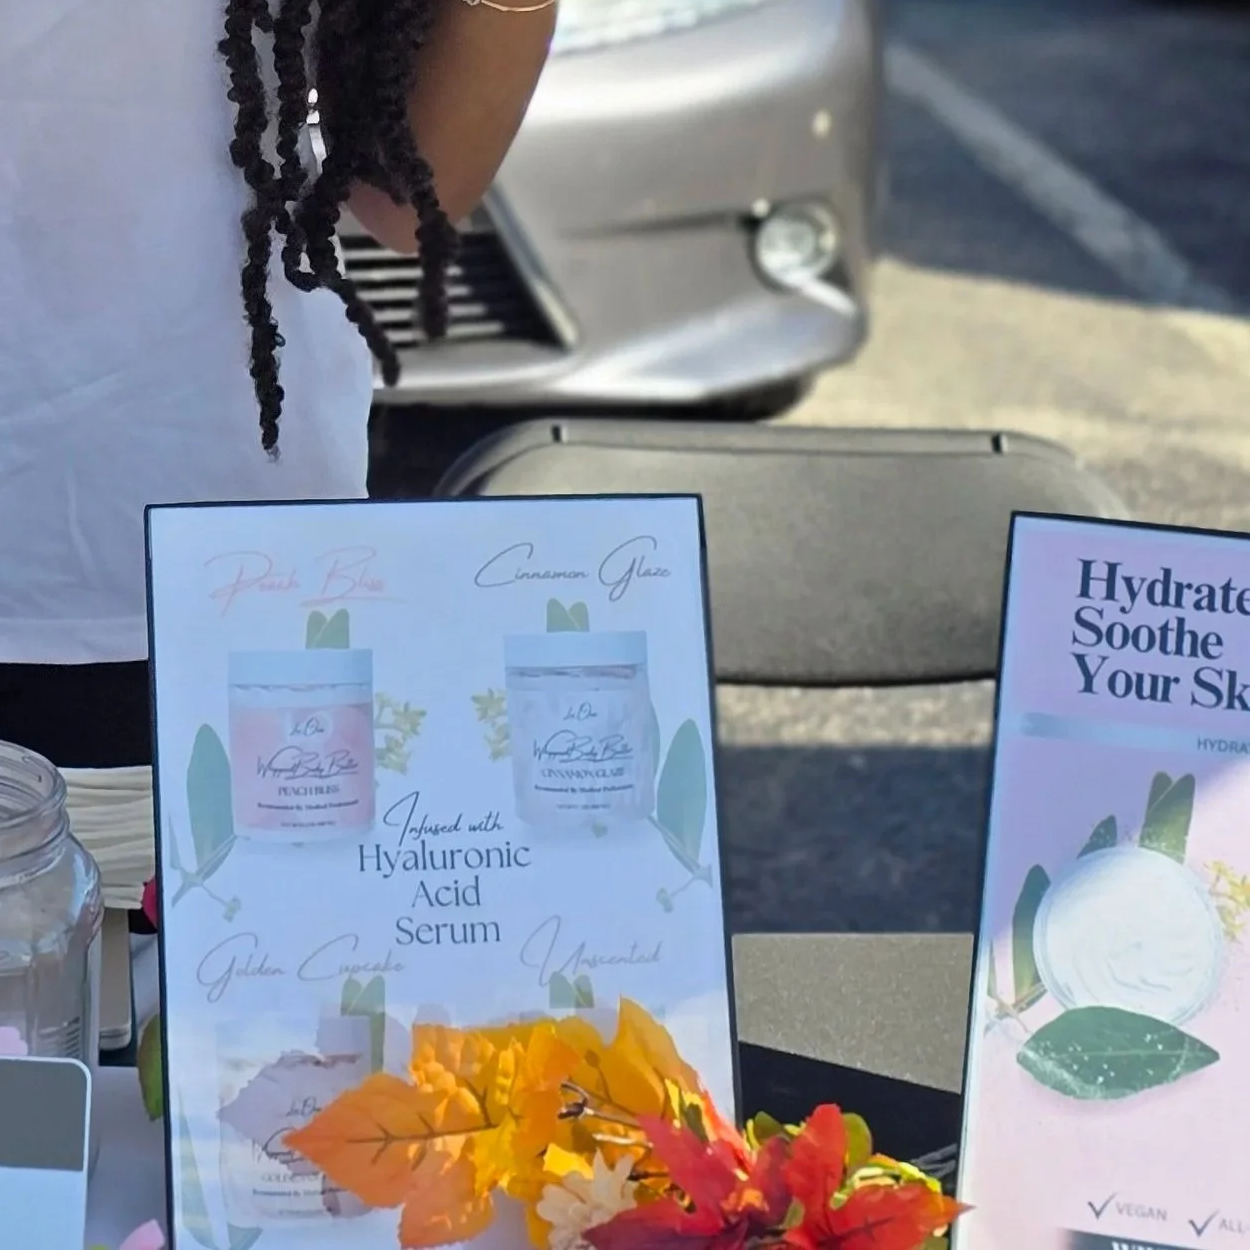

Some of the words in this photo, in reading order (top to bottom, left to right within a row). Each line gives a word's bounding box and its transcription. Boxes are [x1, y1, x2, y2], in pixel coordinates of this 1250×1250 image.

[474, 541, 590, 588] Cinnamon
[598, 534, 672, 602] Glaze
[1071, 605, 1225, 660] Soothe
[1070, 652, 1181, 705] Your
[1189, 665, 1250, 712] Sk
[383, 791, 463, 847] Infused
[468, 810, 504, 833] with
[358, 839, 532, 879] Hyaluronic
[411, 874, 482, 908] Acid
[395, 916, 501, 946] Serum
[519, 914, 662, 987] Unscented
[196, 932, 286, 1003] Golden
[297, 933, 406, 982] Cupcake
[1115, 1202, 1168, 1221] VEGAN
[1218, 1218, 1250, 1235] ALL-
